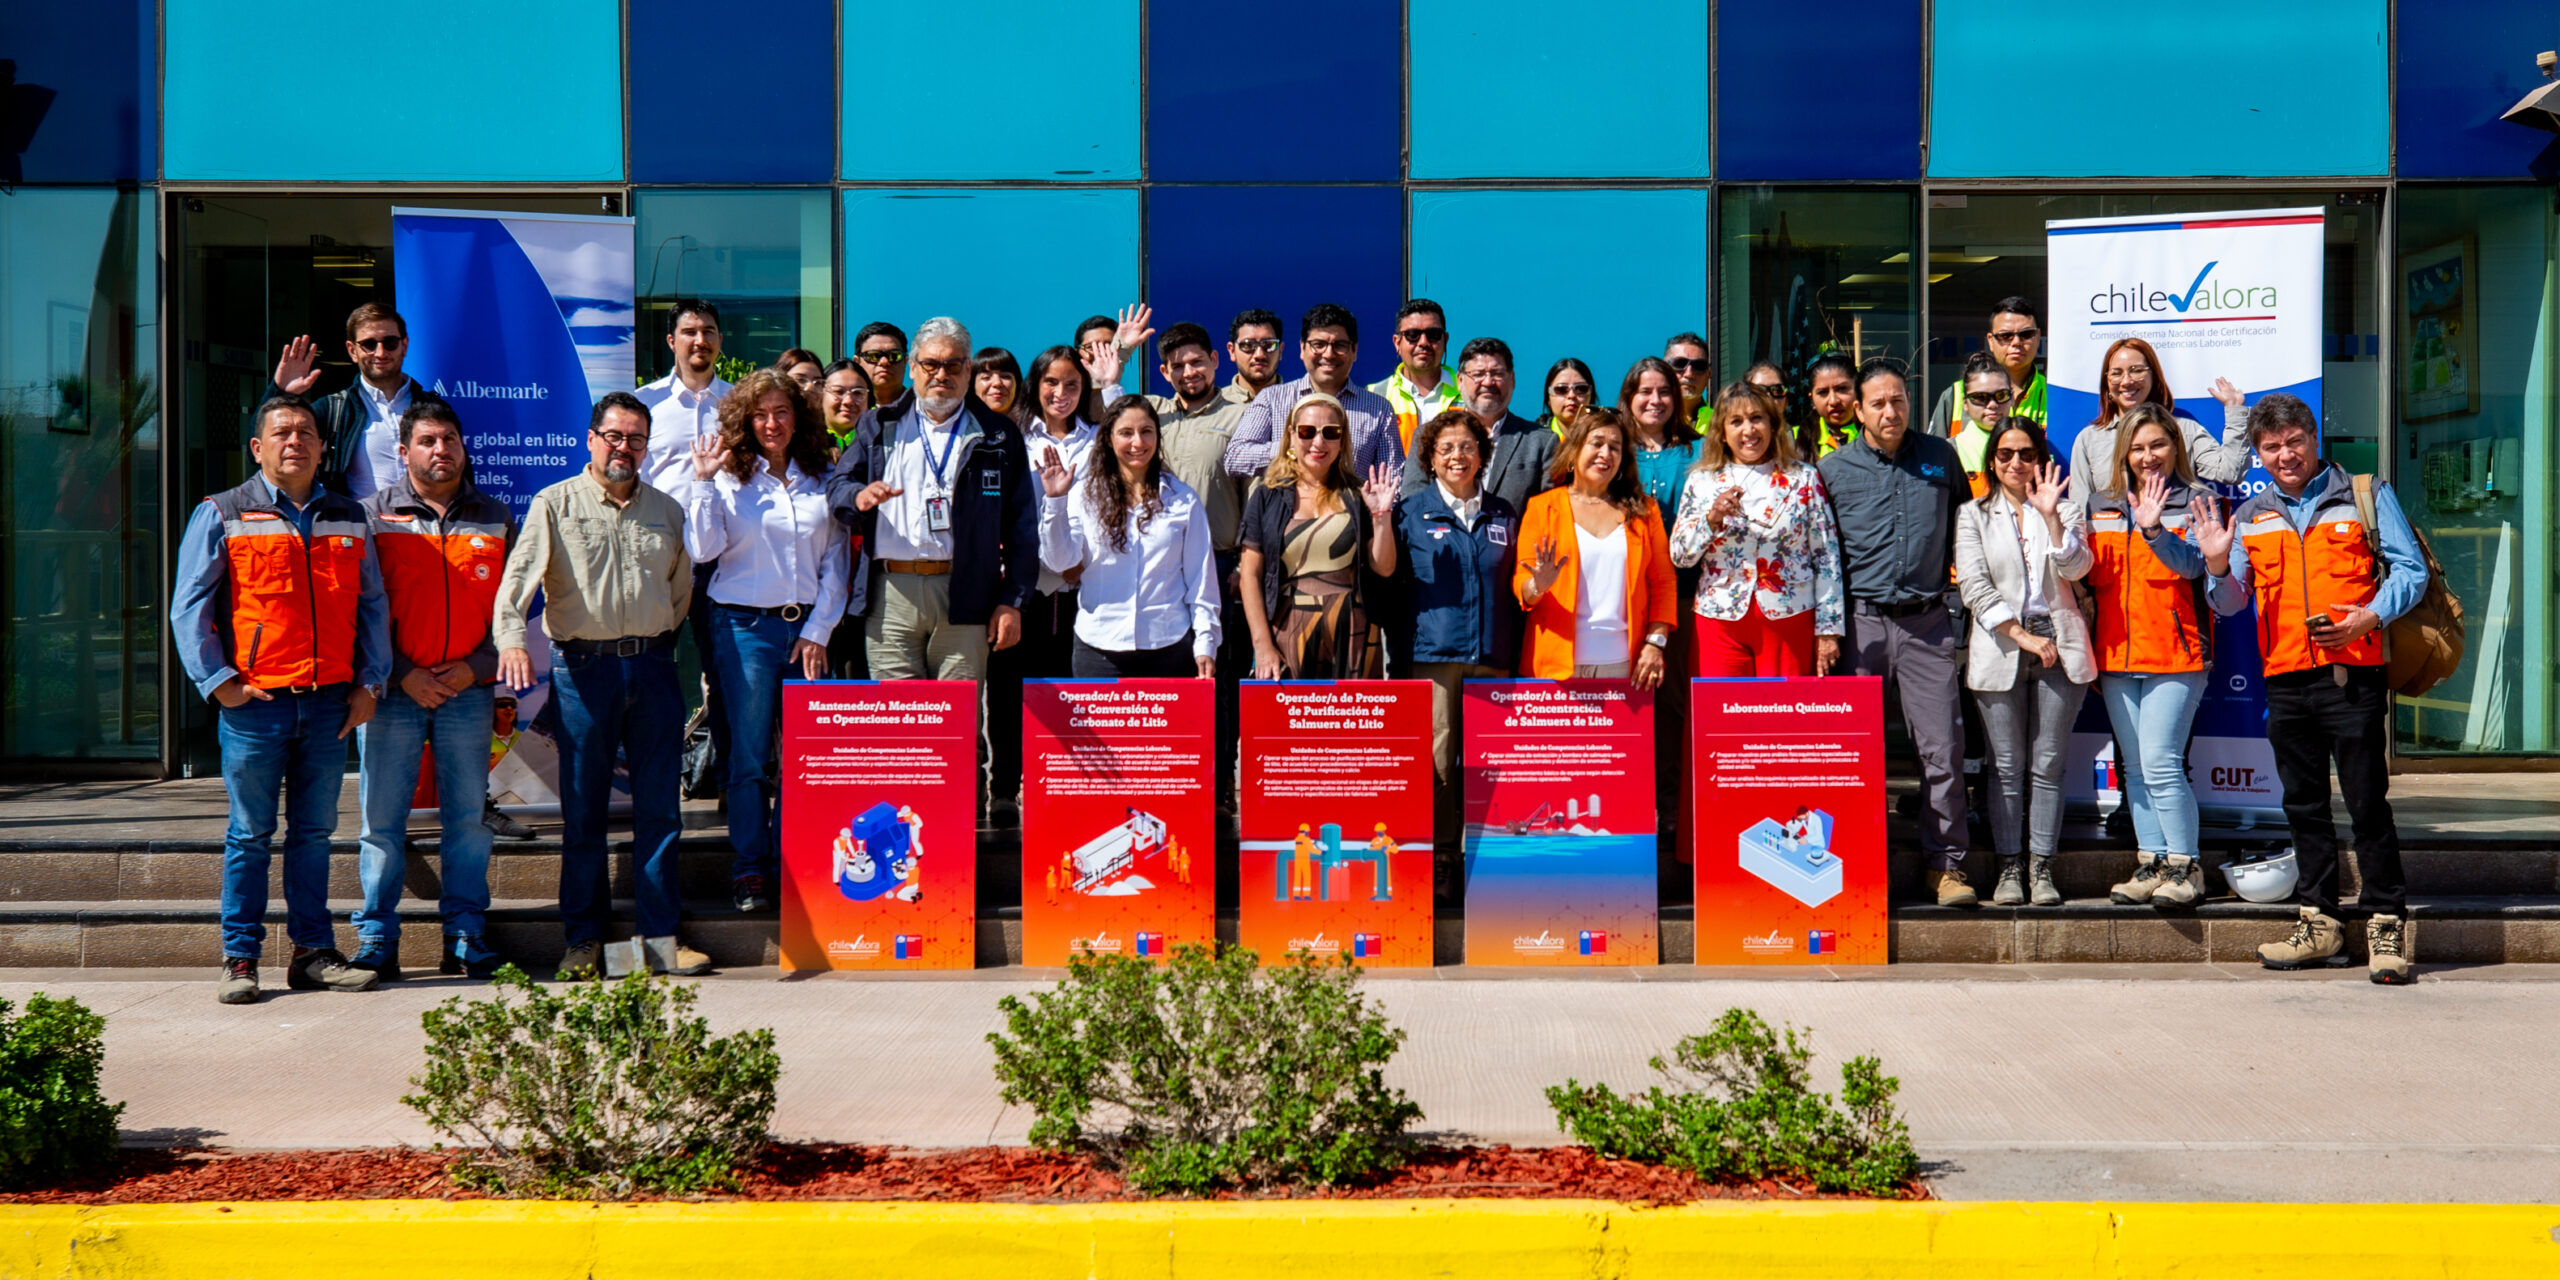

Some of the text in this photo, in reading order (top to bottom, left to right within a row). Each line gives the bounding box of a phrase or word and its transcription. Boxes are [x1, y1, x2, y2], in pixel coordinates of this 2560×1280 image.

[2132, 330, 2166, 339] Sistema
[2168, 329, 2205, 338] Nacional
[2207, 328, 2218, 337] de
[2221, 326, 2277, 336] Certificación
[2200, 338, 2242, 347] Laborales
[452, 380, 549, 399] Albemarle
[473, 432, 520, 449] global
[524, 436, 543, 447] en
[547, 433, 577, 447] litio
[488, 452, 568, 466] elementos
[1059, 691, 1178, 703] Operador/a de Proceso
[1276, 693, 1397, 704] Operador/a de Proceso
[1491, 690, 1626, 702] Operador/a de Extracción
[808, 701, 951, 712] Mantenedor/a Mecánico/a
[1073, 704, 1164, 714] de Conversión de
[1288, 706, 1385, 716] de Purificación de
[1515, 704, 1602, 716] y Concentración
[1723, 702, 1852, 713] Laboratorista Químico/a
[832, 714, 901, 726] Operaciones
[902, 714, 916, 724] de
[917, 714, 943, 724] Litio
[1070, 717, 1168, 727] Carbonato de Litio
[1289, 719, 1384, 729] Salmuera de Litio
[1505, 717, 1613, 726] de Salmuera de Litio
[2211, 766, 2255, 786] CUT
